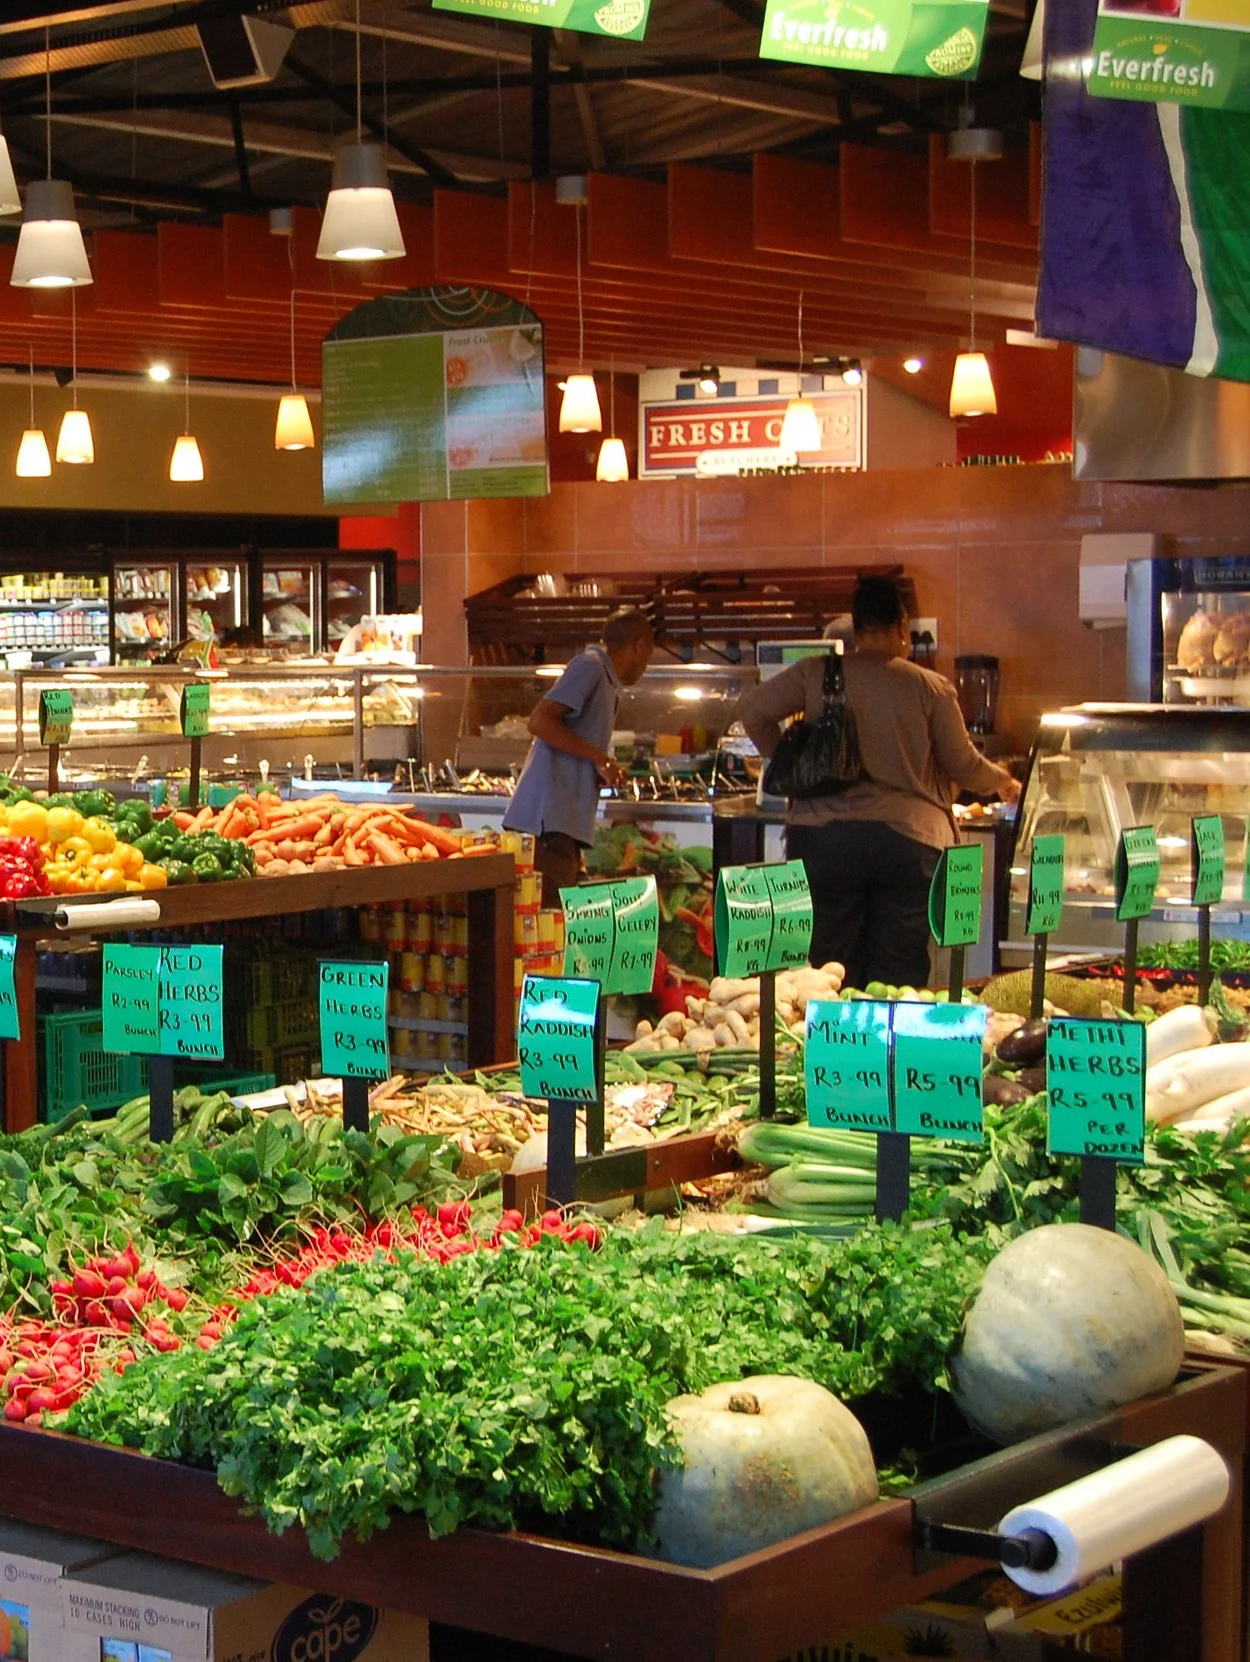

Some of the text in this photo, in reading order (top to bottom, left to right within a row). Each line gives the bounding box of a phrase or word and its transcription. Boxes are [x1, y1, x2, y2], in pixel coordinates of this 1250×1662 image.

[770, 12, 889, 51] Everfresh
[1097, 50, 1216, 88] Everfresh
[650, 414, 851, 447] FRESH CTS
[770, 873, 809, 893] TURNIPS
[730, 904, 771, 920] RADDISH
[618, 915, 656, 933] CELERY
[567, 928, 608, 946] ONIONS
[160, 946, 203, 973] RED
[105, 960, 153, 981] PARSLEY
[321, 966, 385, 989] GREEN
[158, 981, 220, 1003] HERBS
[523, 980, 568, 1005] RED
[124, 1023, 157, 1037] BUNCH
[520, 1012, 594, 1041] RADDISH
[807, 1020, 869, 1046] MINT
[1047, 1021, 1126, 1046] METHI
[177, 1039, 219, 1055] BUNCH
[346, 1062, 387, 1079] BUNCH
[1048, 1053, 1141, 1077] HERBS
[539, 1080, 594, 1100] BUNCH
[825, 1106, 890, 1127] BUNCH
[919, 1112, 983, 1133] BUNCH
[1087, 1120, 1130, 1136] PER
[1083, 1138, 1143, 1155] DOZEN
[69, 1594, 140, 1619] MAXIMUM STACKING
[70, 1607, 141, 1632] 10 CASES HIGH
[159, 1615, 200, 1631] DO NOT LIFT
[290, 1614, 361, 1662] cape
